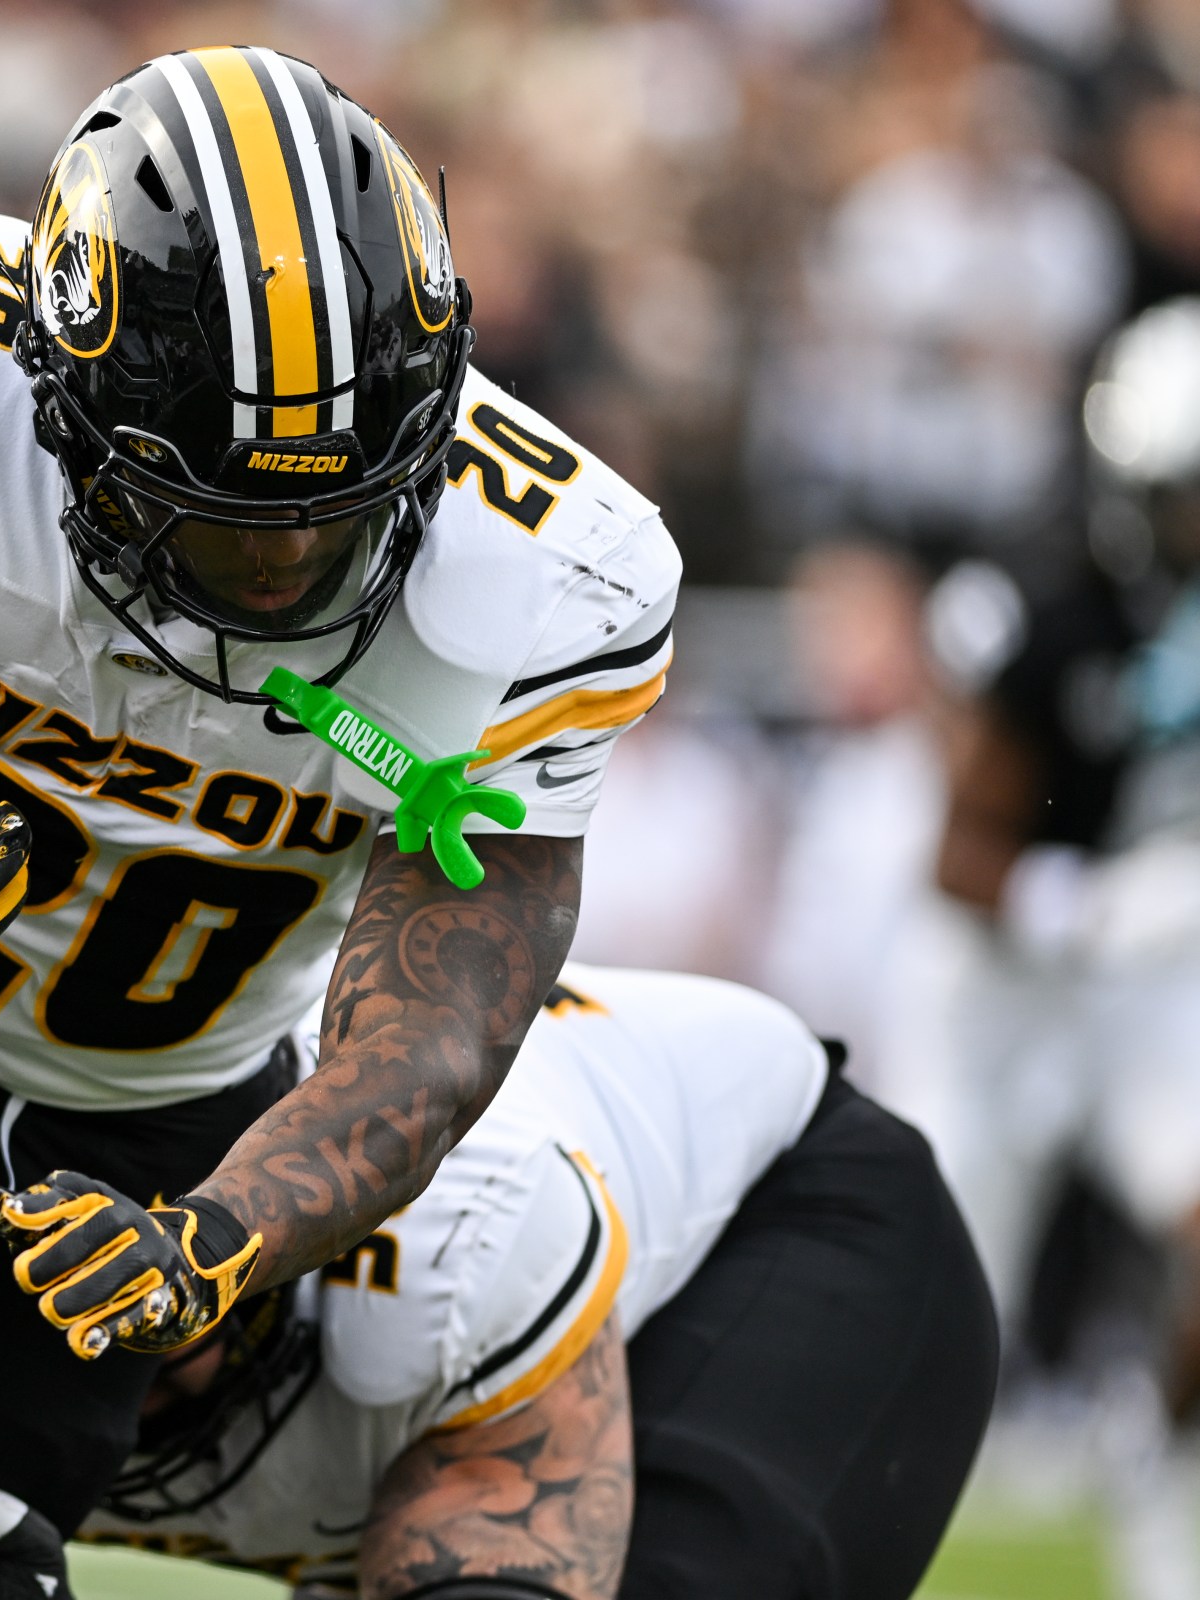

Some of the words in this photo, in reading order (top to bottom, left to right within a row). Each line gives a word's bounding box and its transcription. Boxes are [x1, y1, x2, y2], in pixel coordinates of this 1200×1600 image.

[247, 451, 349, 474] MIZZOU
[446, 401, 583, 537] 20
[328, 709, 414, 788] NXTRND
[262, 1086, 430, 1217] SKY
